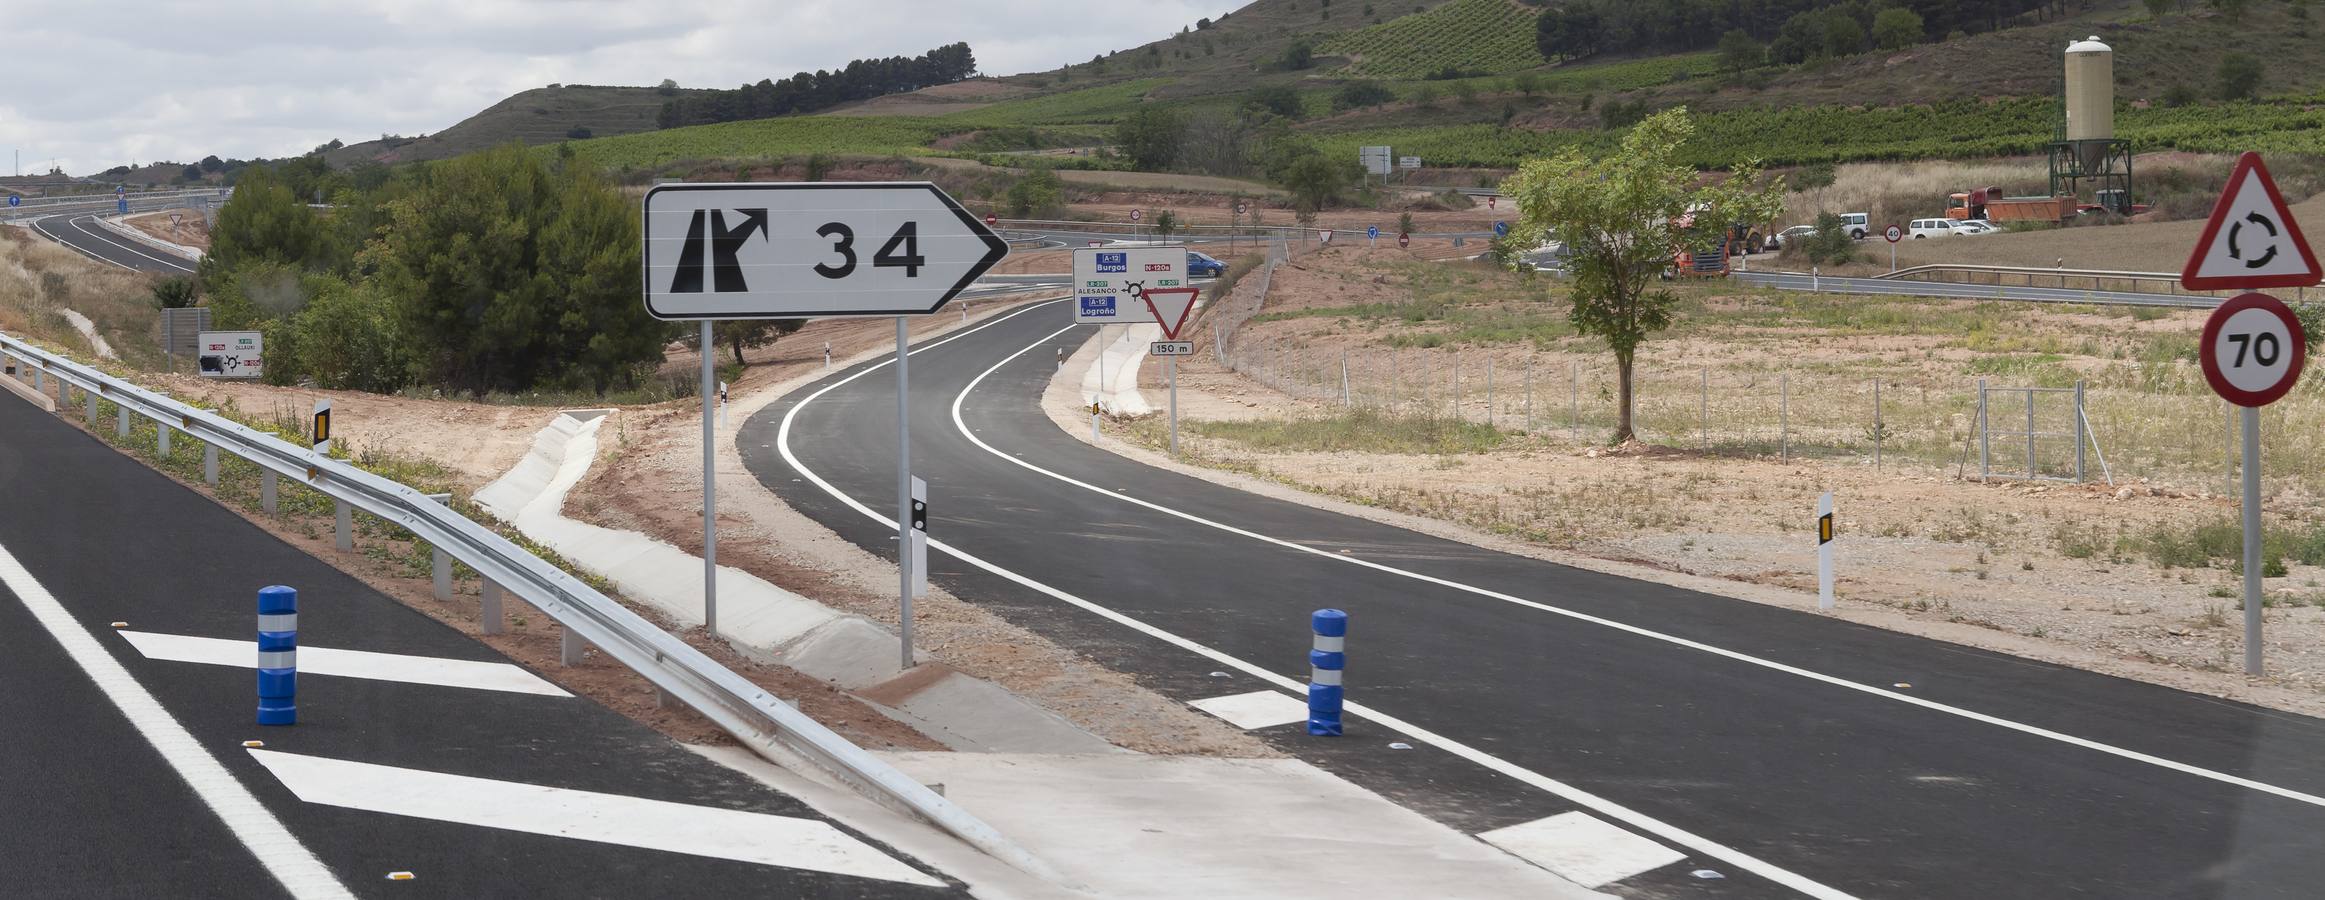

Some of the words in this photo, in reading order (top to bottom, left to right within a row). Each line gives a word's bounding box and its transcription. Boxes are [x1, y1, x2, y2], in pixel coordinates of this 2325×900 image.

[813, 222, 925, 279] 34
[1097, 264, 1126, 272] Burgos
[1081, 308, 1115, 316] Logroño
[1157, 344, 1175, 353] 150
[2228, 332, 2280, 368] 70
